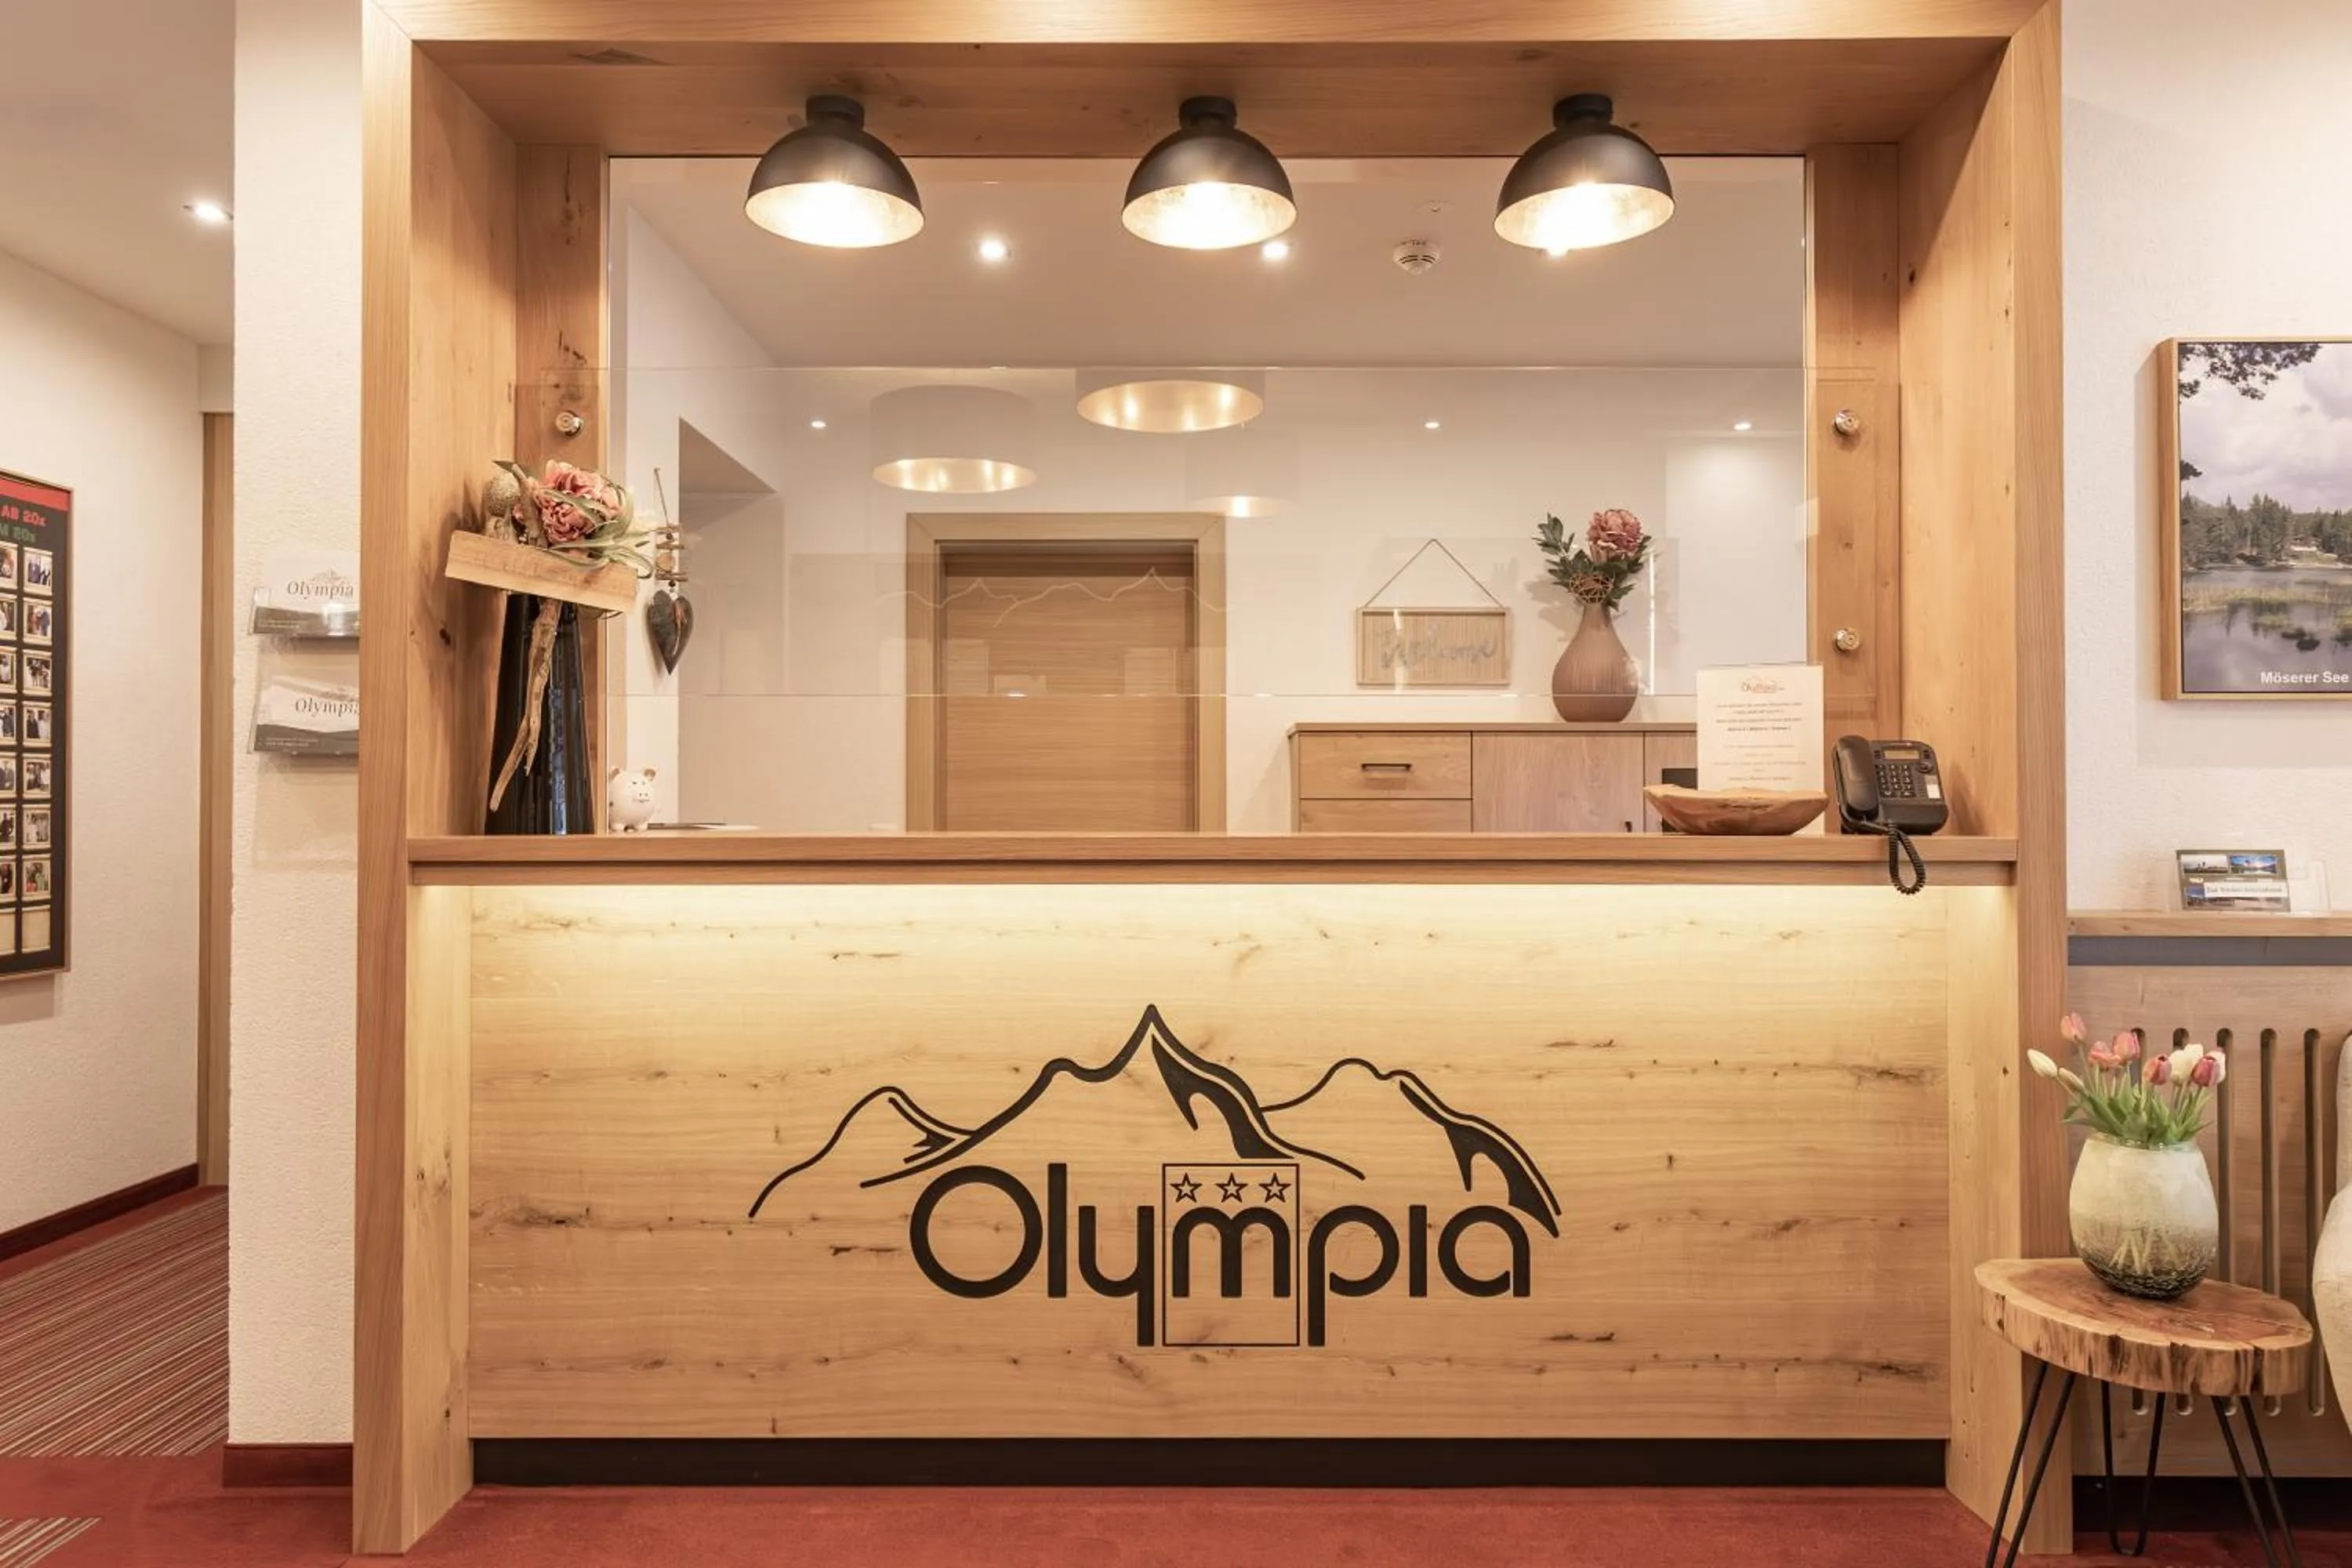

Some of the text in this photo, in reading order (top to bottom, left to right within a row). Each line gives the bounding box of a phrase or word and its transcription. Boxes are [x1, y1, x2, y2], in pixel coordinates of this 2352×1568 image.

[287, 580, 354, 600] Olympia
[2260, 670, 2350, 684] Möserer See
[909, 1163, 1530, 1346] Olympia
